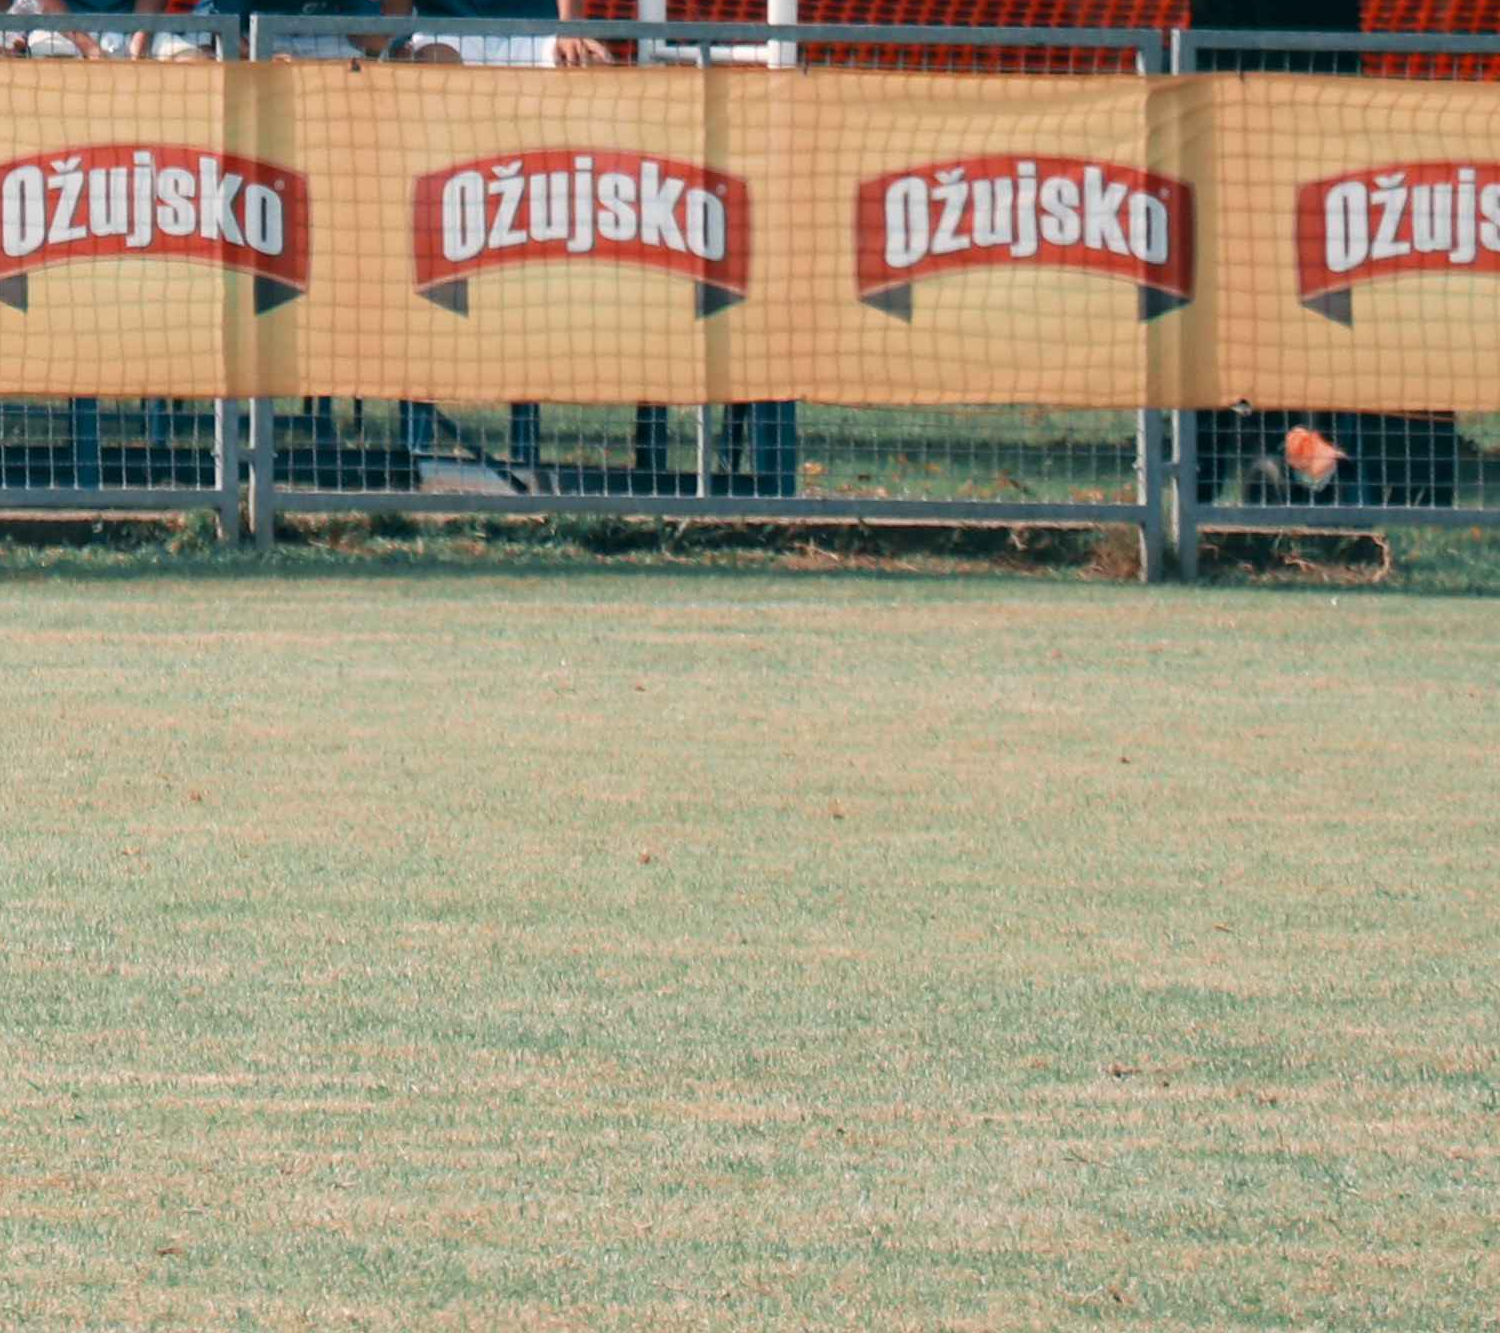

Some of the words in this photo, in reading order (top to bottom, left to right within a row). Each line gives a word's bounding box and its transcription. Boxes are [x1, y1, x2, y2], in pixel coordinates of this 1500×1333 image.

[1, 150, 284, 257] Ožujsko
[441, 156, 726, 263] Ožujsko
[883, 161, 1168, 267] Ožujsko
[1325, 167, 1500, 272] Ožujs
